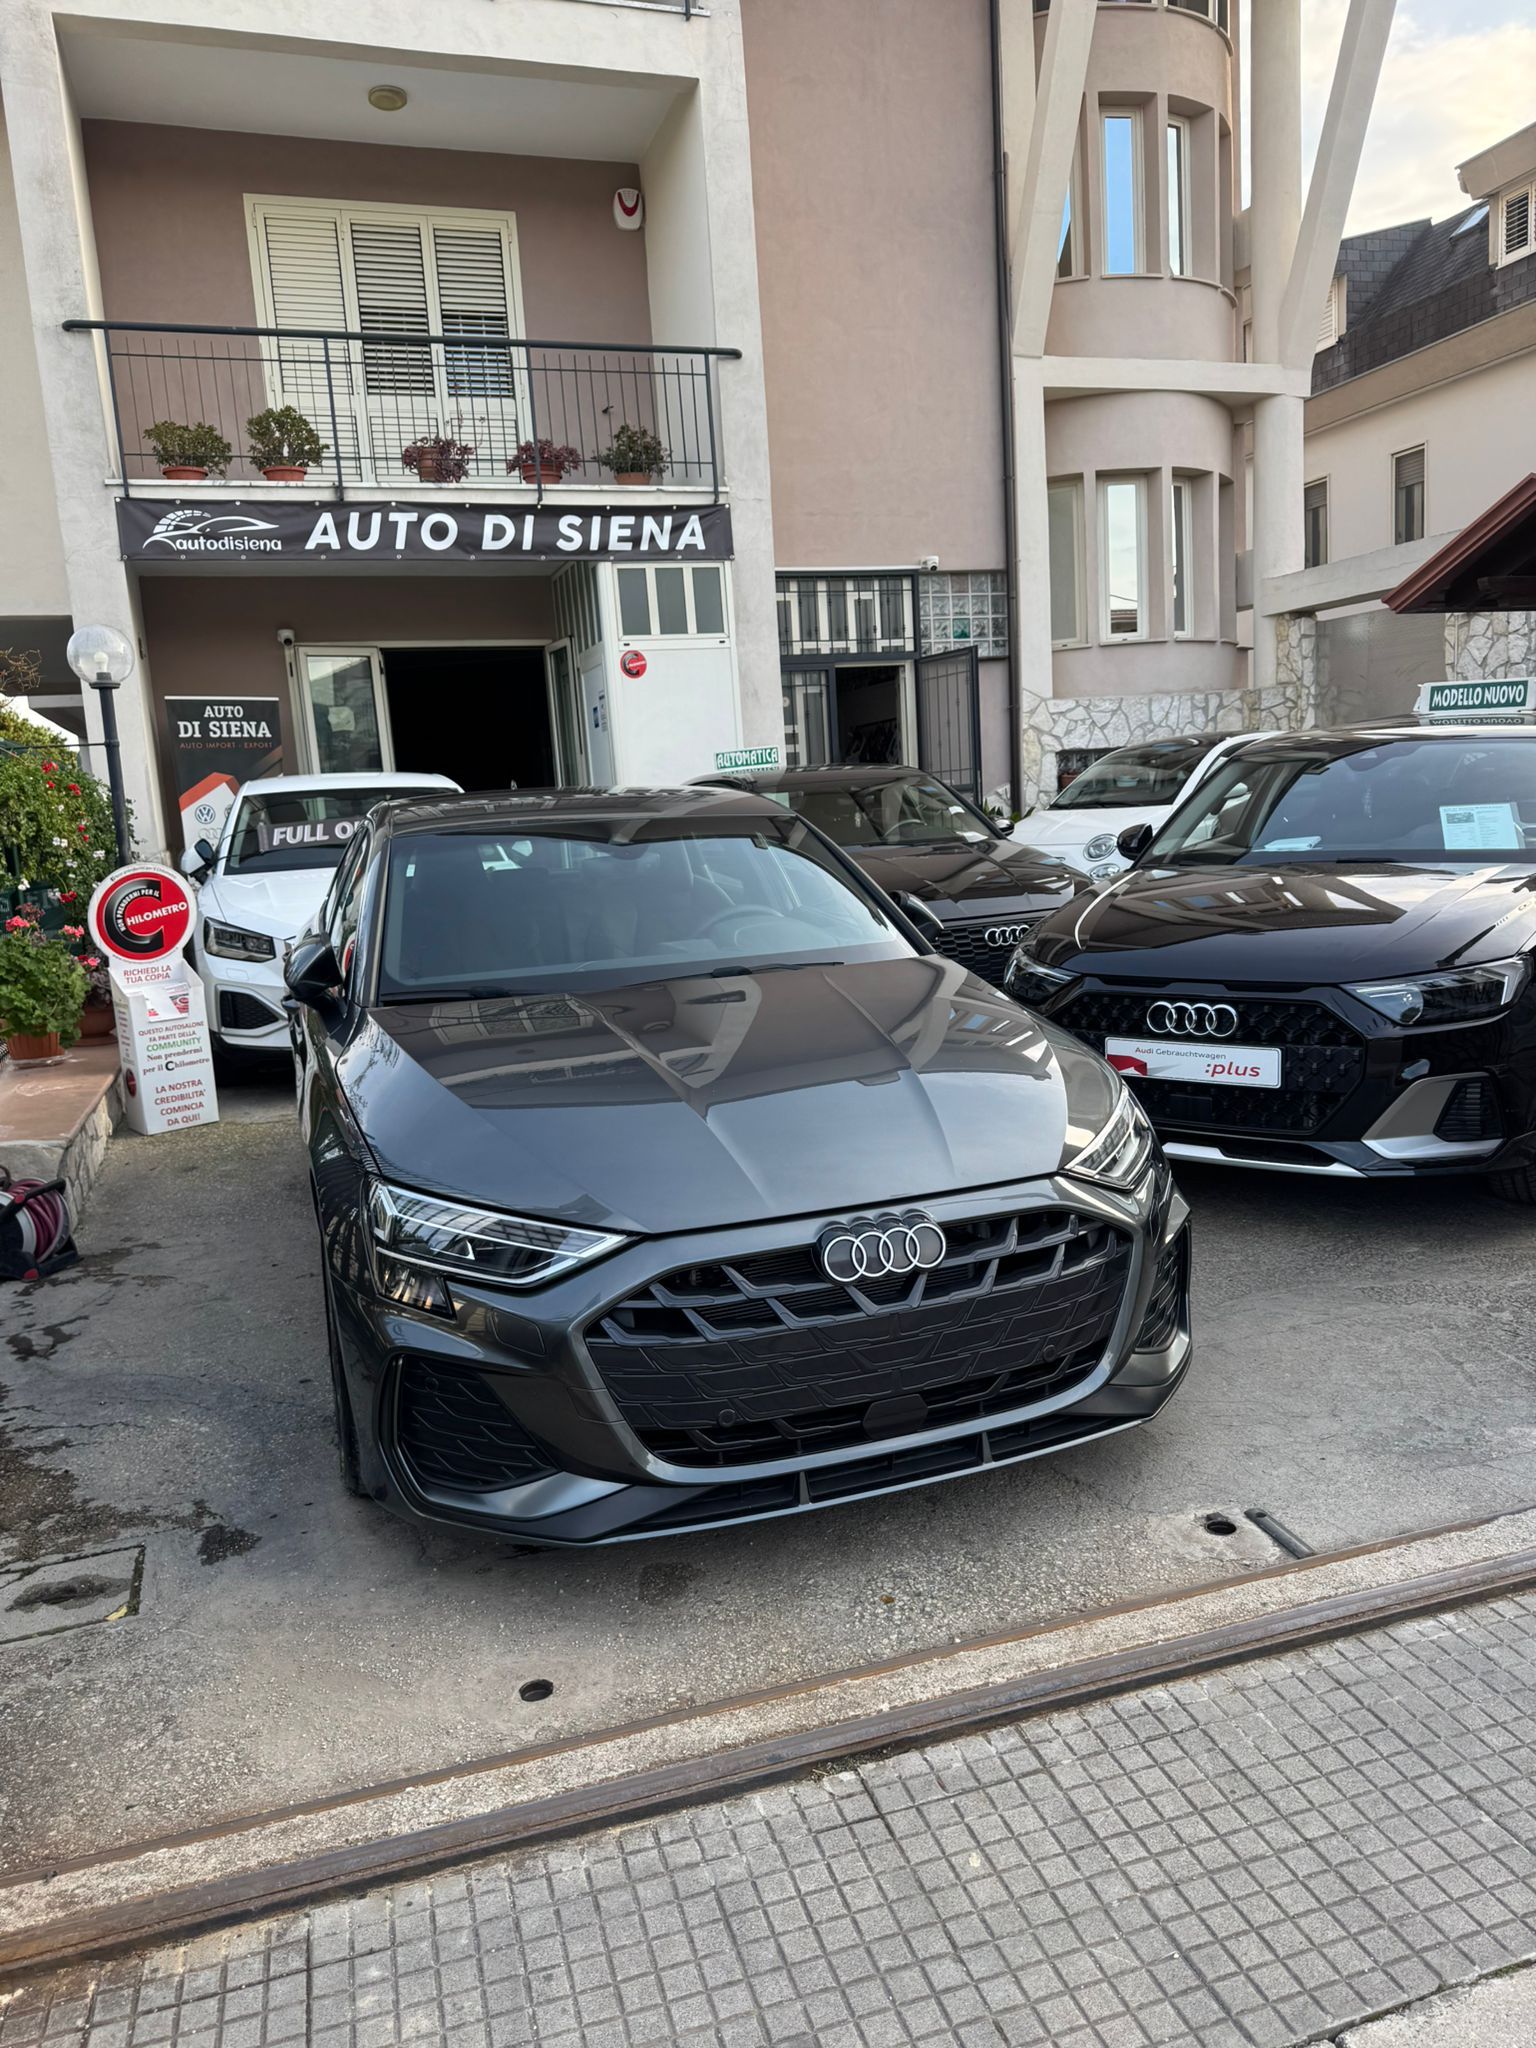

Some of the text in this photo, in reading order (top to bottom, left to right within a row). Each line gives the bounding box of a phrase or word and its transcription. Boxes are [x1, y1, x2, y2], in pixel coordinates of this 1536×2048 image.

[304, 511, 707, 552] AUTO DI SIENA
[175, 536, 282, 551] autodisiena
[1431, 684, 1525, 708] MODELLO NUOVO
[203, 705, 244, 718] AUTO
[177, 721, 272, 738] DI SIENA
[717, 748, 778, 768] AUTOMATICA
[272, 823, 329, 846] FULL
[123, 966, 160, 977] RICHIEDI
[126, 972, 171, 984] TUA COPIA
[138, 1021, 204, 1036] QUESTO AUTOSALONE
[158, 1033, 176, 1041] PARTE
[178, 1030, 197, 1038] DELLA
[146, 1037, 202, 1052] COMMUNITY
[164, 1046, 203, 1060] prendermi
[1135, 1047, 1227, 1060] Audi Gebrauchtwagen
[143, 1066, 156, 1075] per
[165, 1057, 210, 1071] Chilometro
[155, 1079, 203, 1094] LA NOSTRA
[160, 1101, 204, 1116] COMINCIA
[167, 1117, 180, 1126] DA
